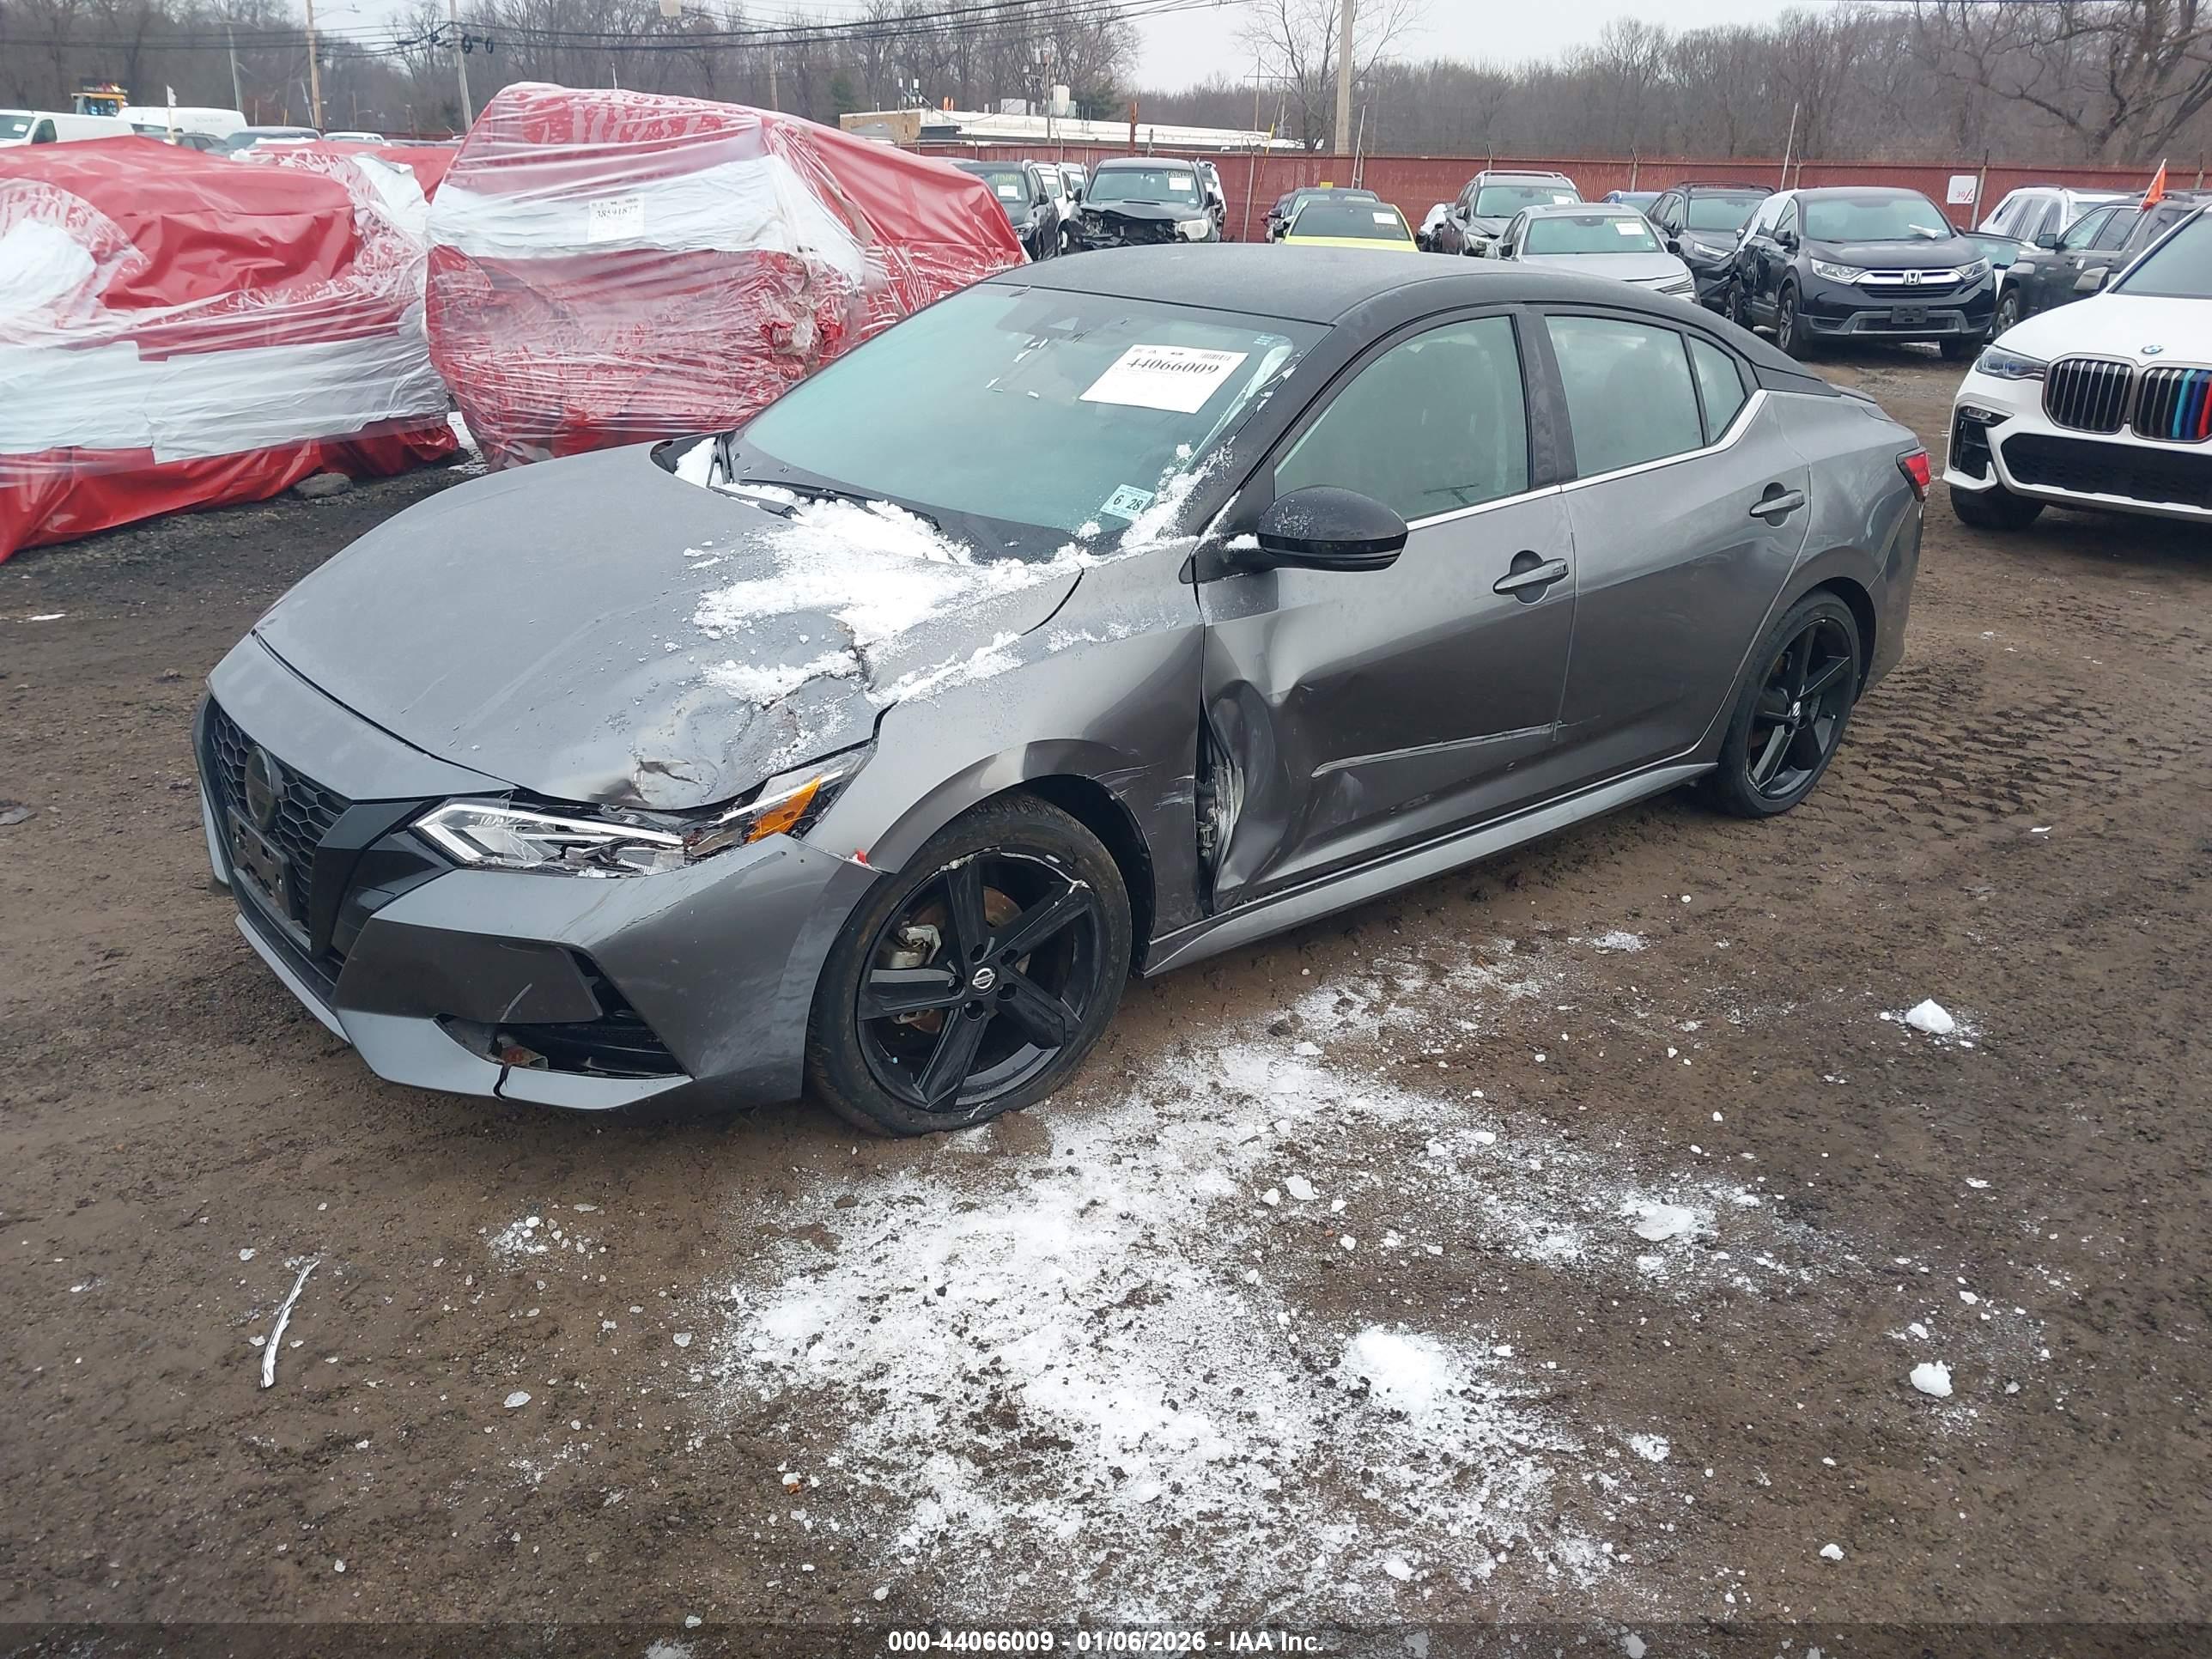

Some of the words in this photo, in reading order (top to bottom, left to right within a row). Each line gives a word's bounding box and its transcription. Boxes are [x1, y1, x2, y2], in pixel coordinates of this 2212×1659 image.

[1127, 357, 1219, 375] 44066009
[1113, 494, 1124, 506] 6
[1125, 498, 1144, 511] 28
